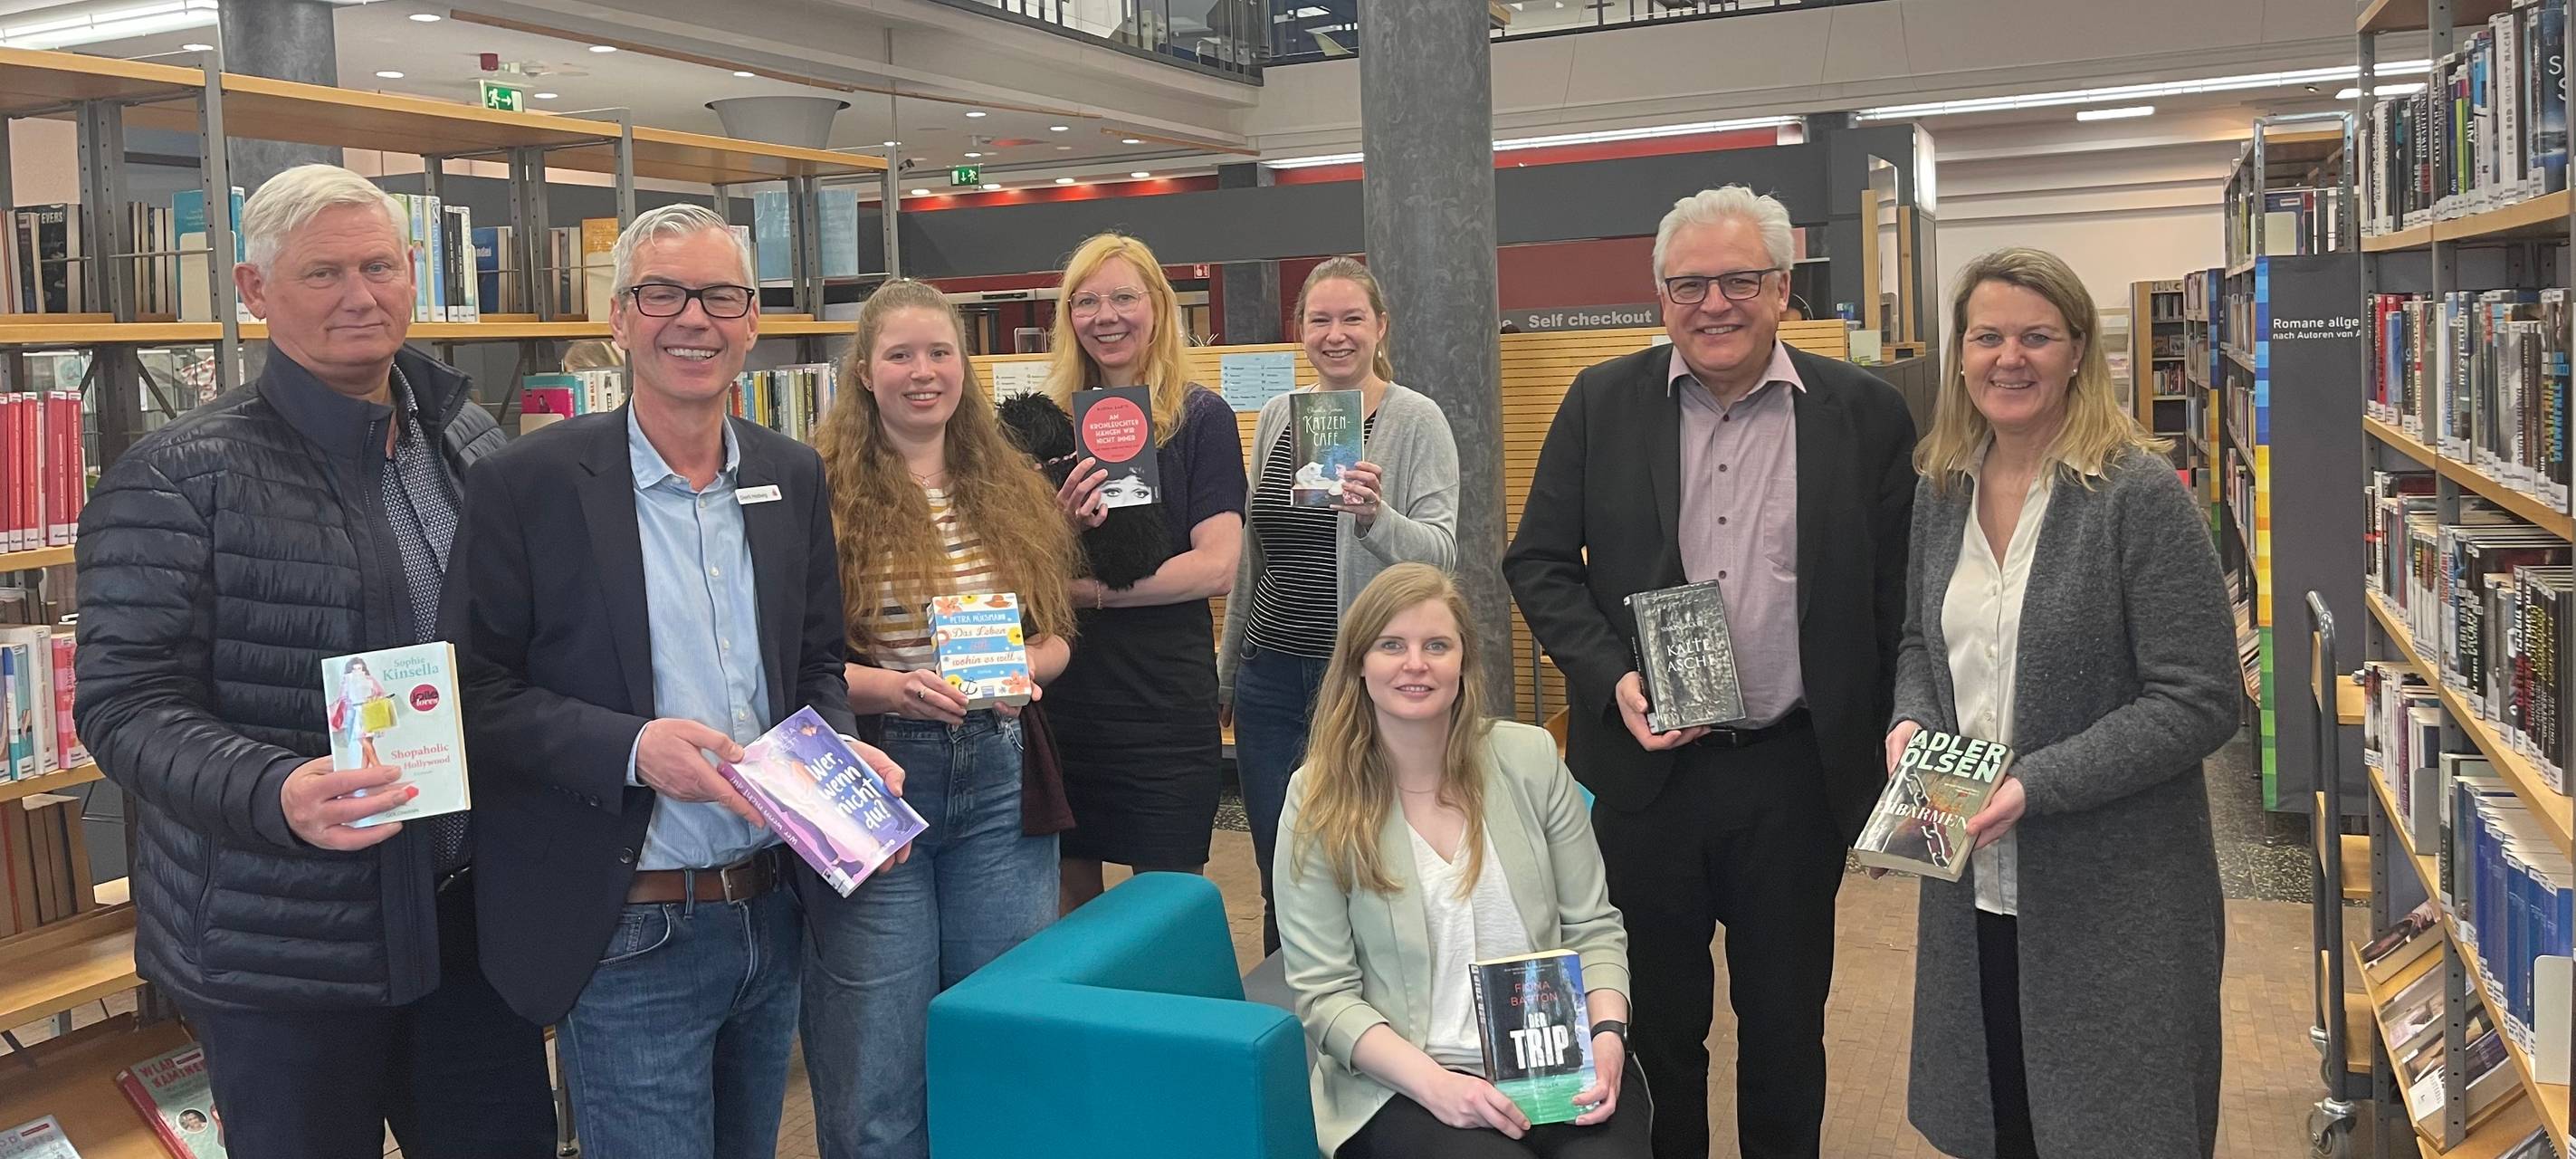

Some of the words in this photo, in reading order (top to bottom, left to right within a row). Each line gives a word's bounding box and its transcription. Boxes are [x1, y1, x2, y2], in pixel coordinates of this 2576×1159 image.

[41, 211, 63, 225] EVERS
[1528, 313, 1564, 329] Self
[1568, 310, 1653, 327] checkout
[2272, 318, 2324, 330] Romane
[2272, 331, 2295, 340] nach
[2296, 330, 2334, 340] Autoren
[1302, 415, 1351, 434] KATZEN-
[951, 627, 973, 637] Das
[1666, 637, 1711, 656] KALTE
[394, 656, 425, 668] Sophie
[952, 656, 981, 666] wohin
[997, 652, 1015, 663] will
[1667, 654, 1716, 673] ASCHE
[383, 663, 439, 681] Kinsella
[390, 742, 450, 760] Shopaholic
[1908, 729, 2007, 764] ADLER
[404, 755, 451, 770] Hollywood
[804, 751, 844, 781] Wer,
[1900, 748, 2000, 783] OLSEN
[818, 764, 863, 800] wenn
[835, 776, 882, 819] nicht
[864, 800, 892, 830] du?
[1514, 981, 1550, 993] FIONA
[1510, 991, 1558, 1007] BARTON
[1527, 1011, 1547, 1029] DER
[1509, 1024, 1569, 1070] TRIP
